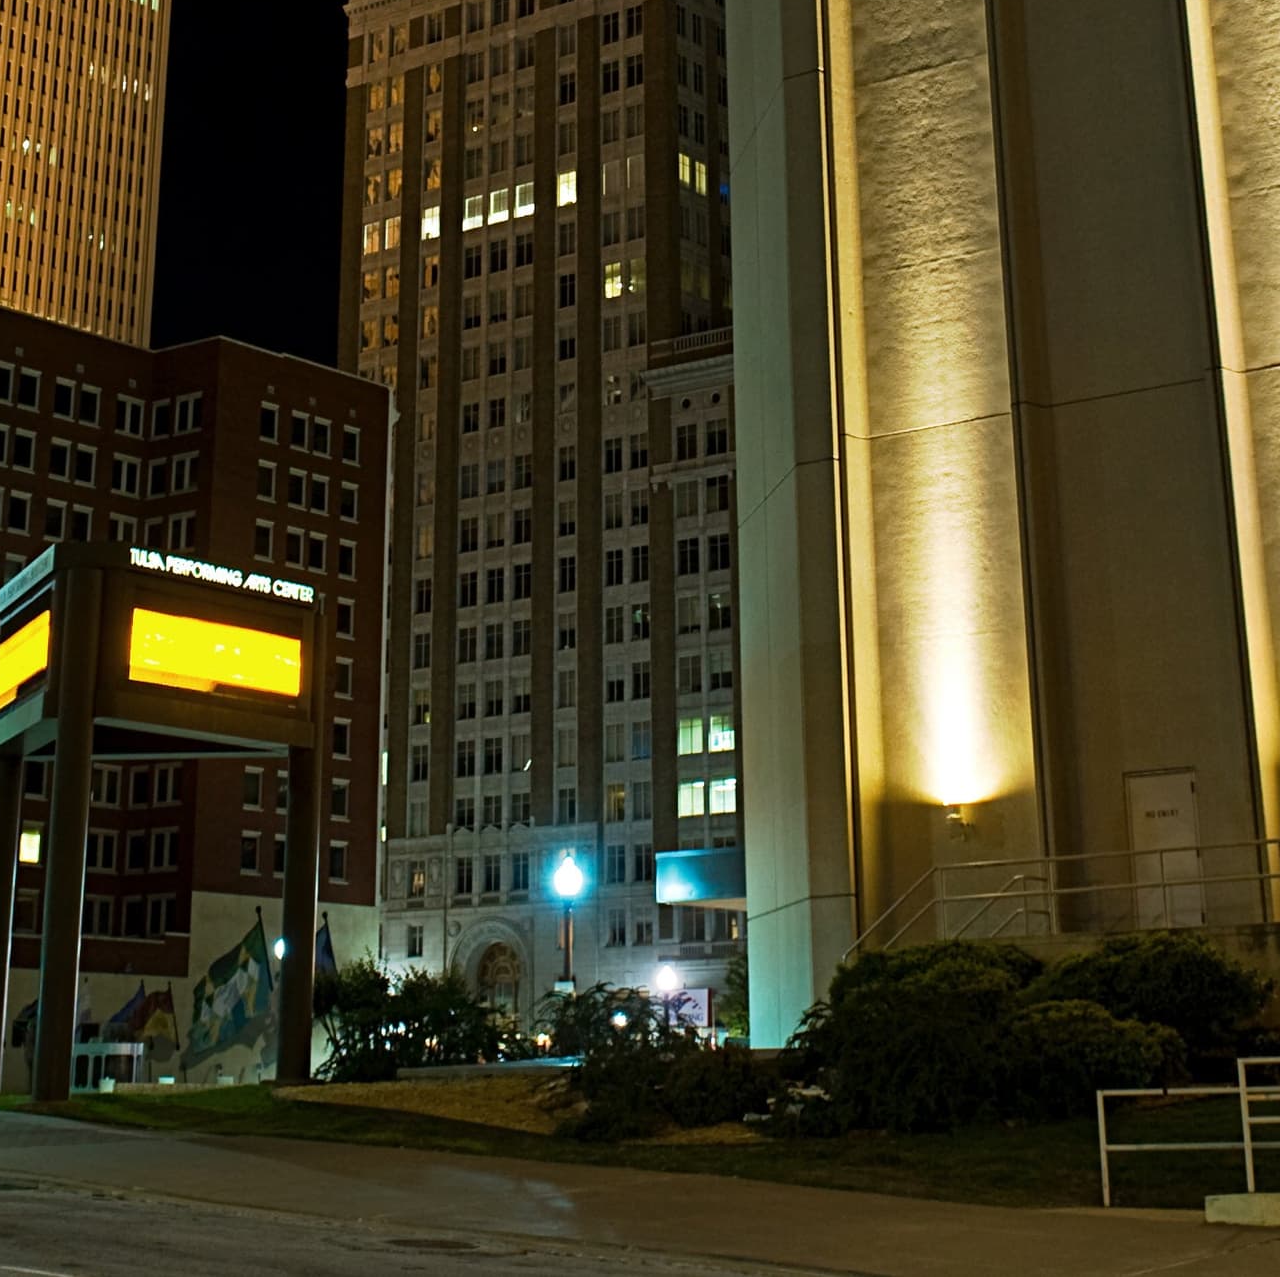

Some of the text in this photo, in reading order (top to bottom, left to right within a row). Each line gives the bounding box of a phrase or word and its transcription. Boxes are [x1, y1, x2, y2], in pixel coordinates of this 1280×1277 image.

[129, 547, 315, 604] TULSA PERFORMING ARTS CENTER
